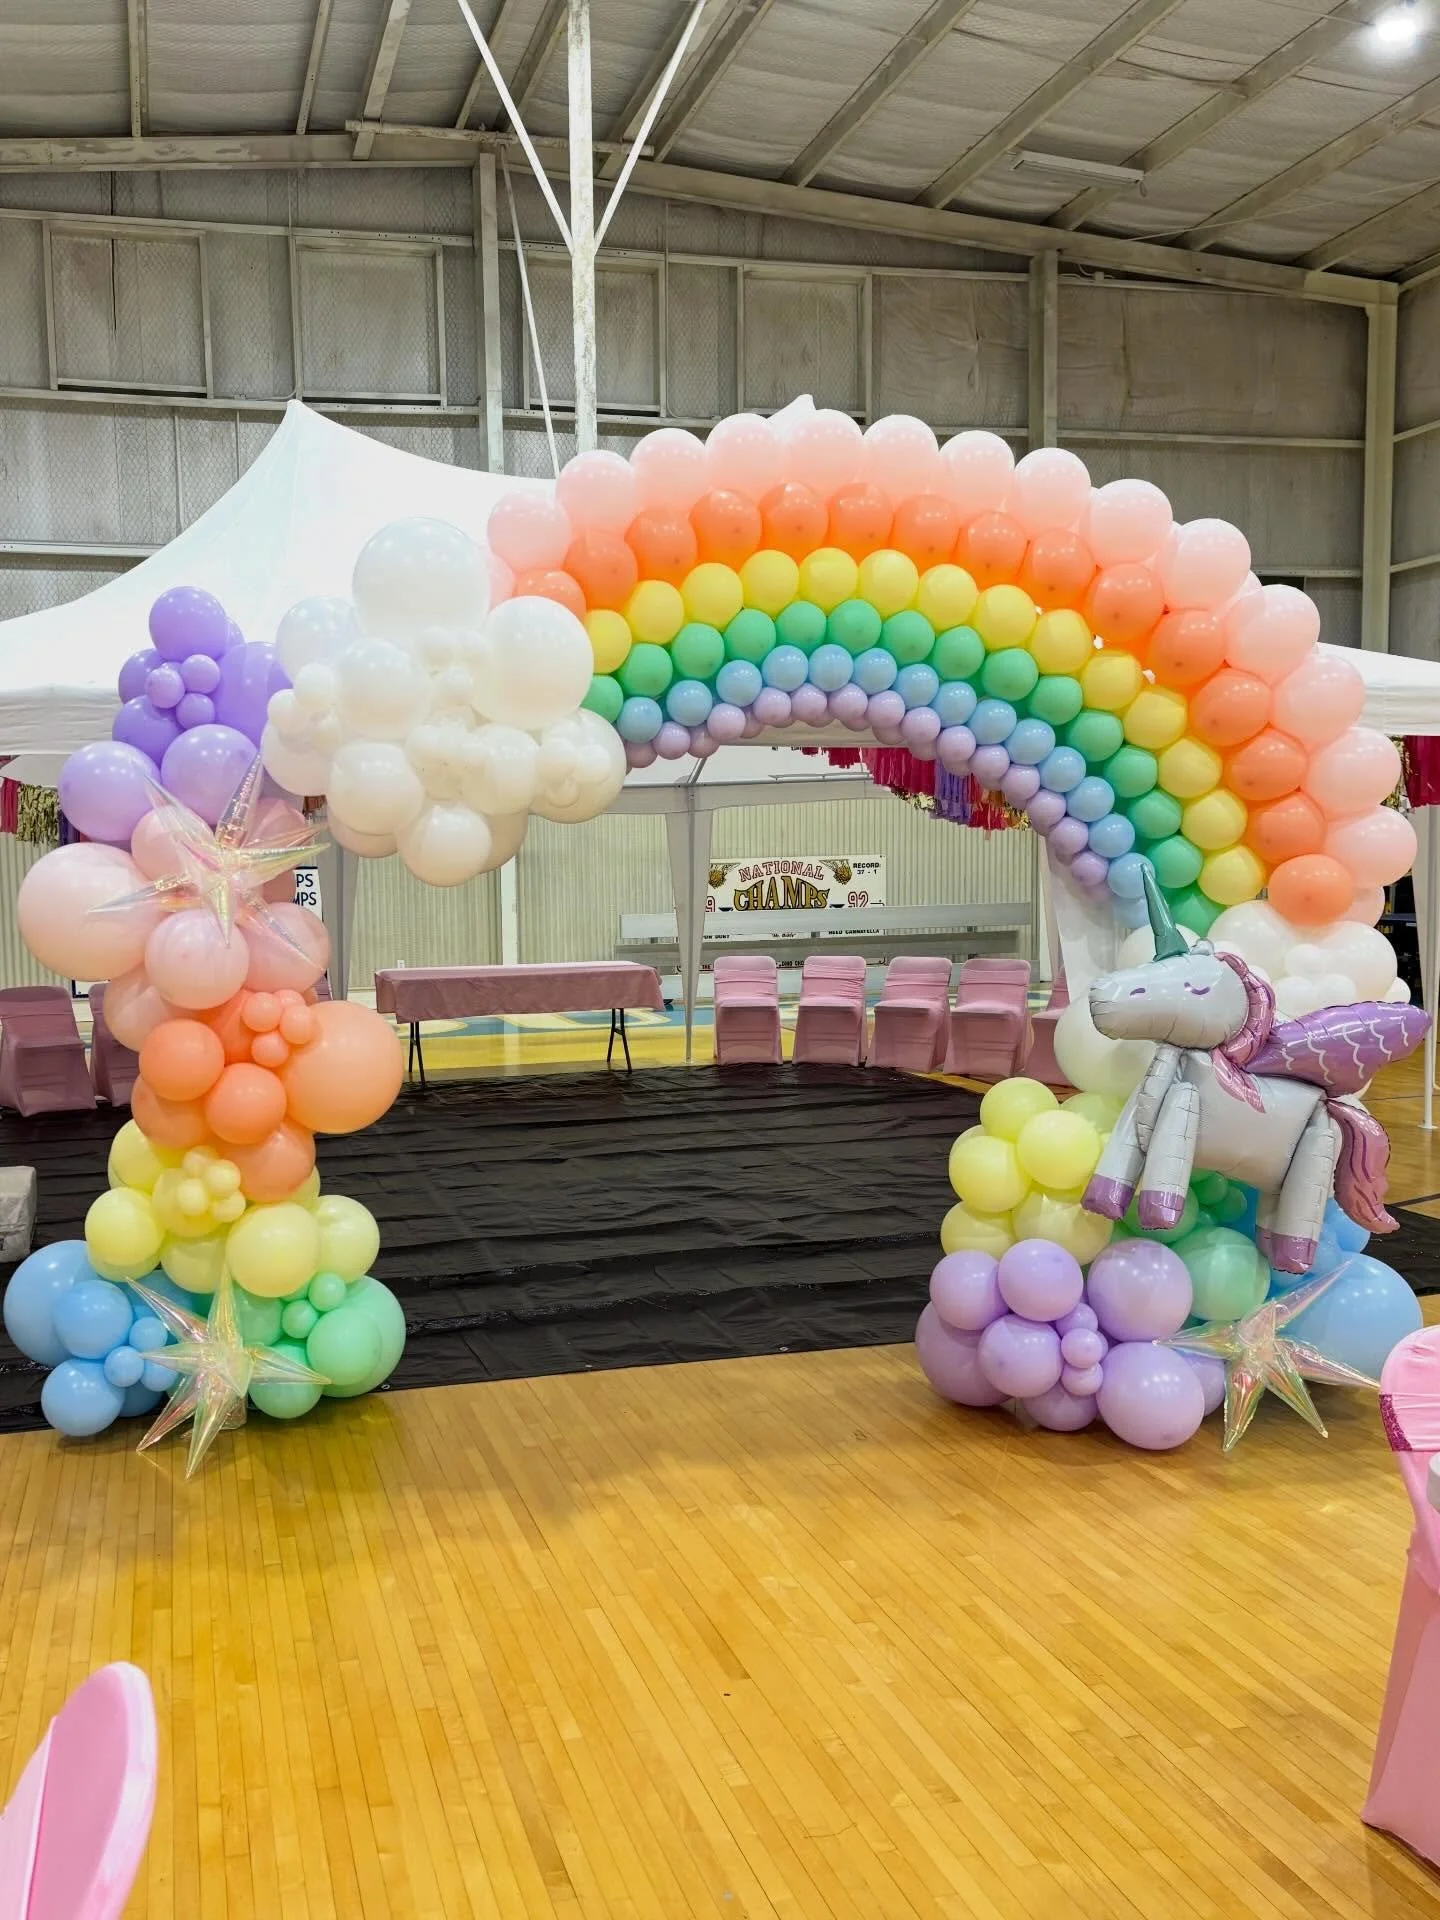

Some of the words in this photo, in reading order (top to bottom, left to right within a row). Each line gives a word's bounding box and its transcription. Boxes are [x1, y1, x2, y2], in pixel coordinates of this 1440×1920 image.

[738, 860, 825, 882] NATIONAL
[733, 876, 830, 911] CHAMPS
[848, 891, 868, 908] 92
